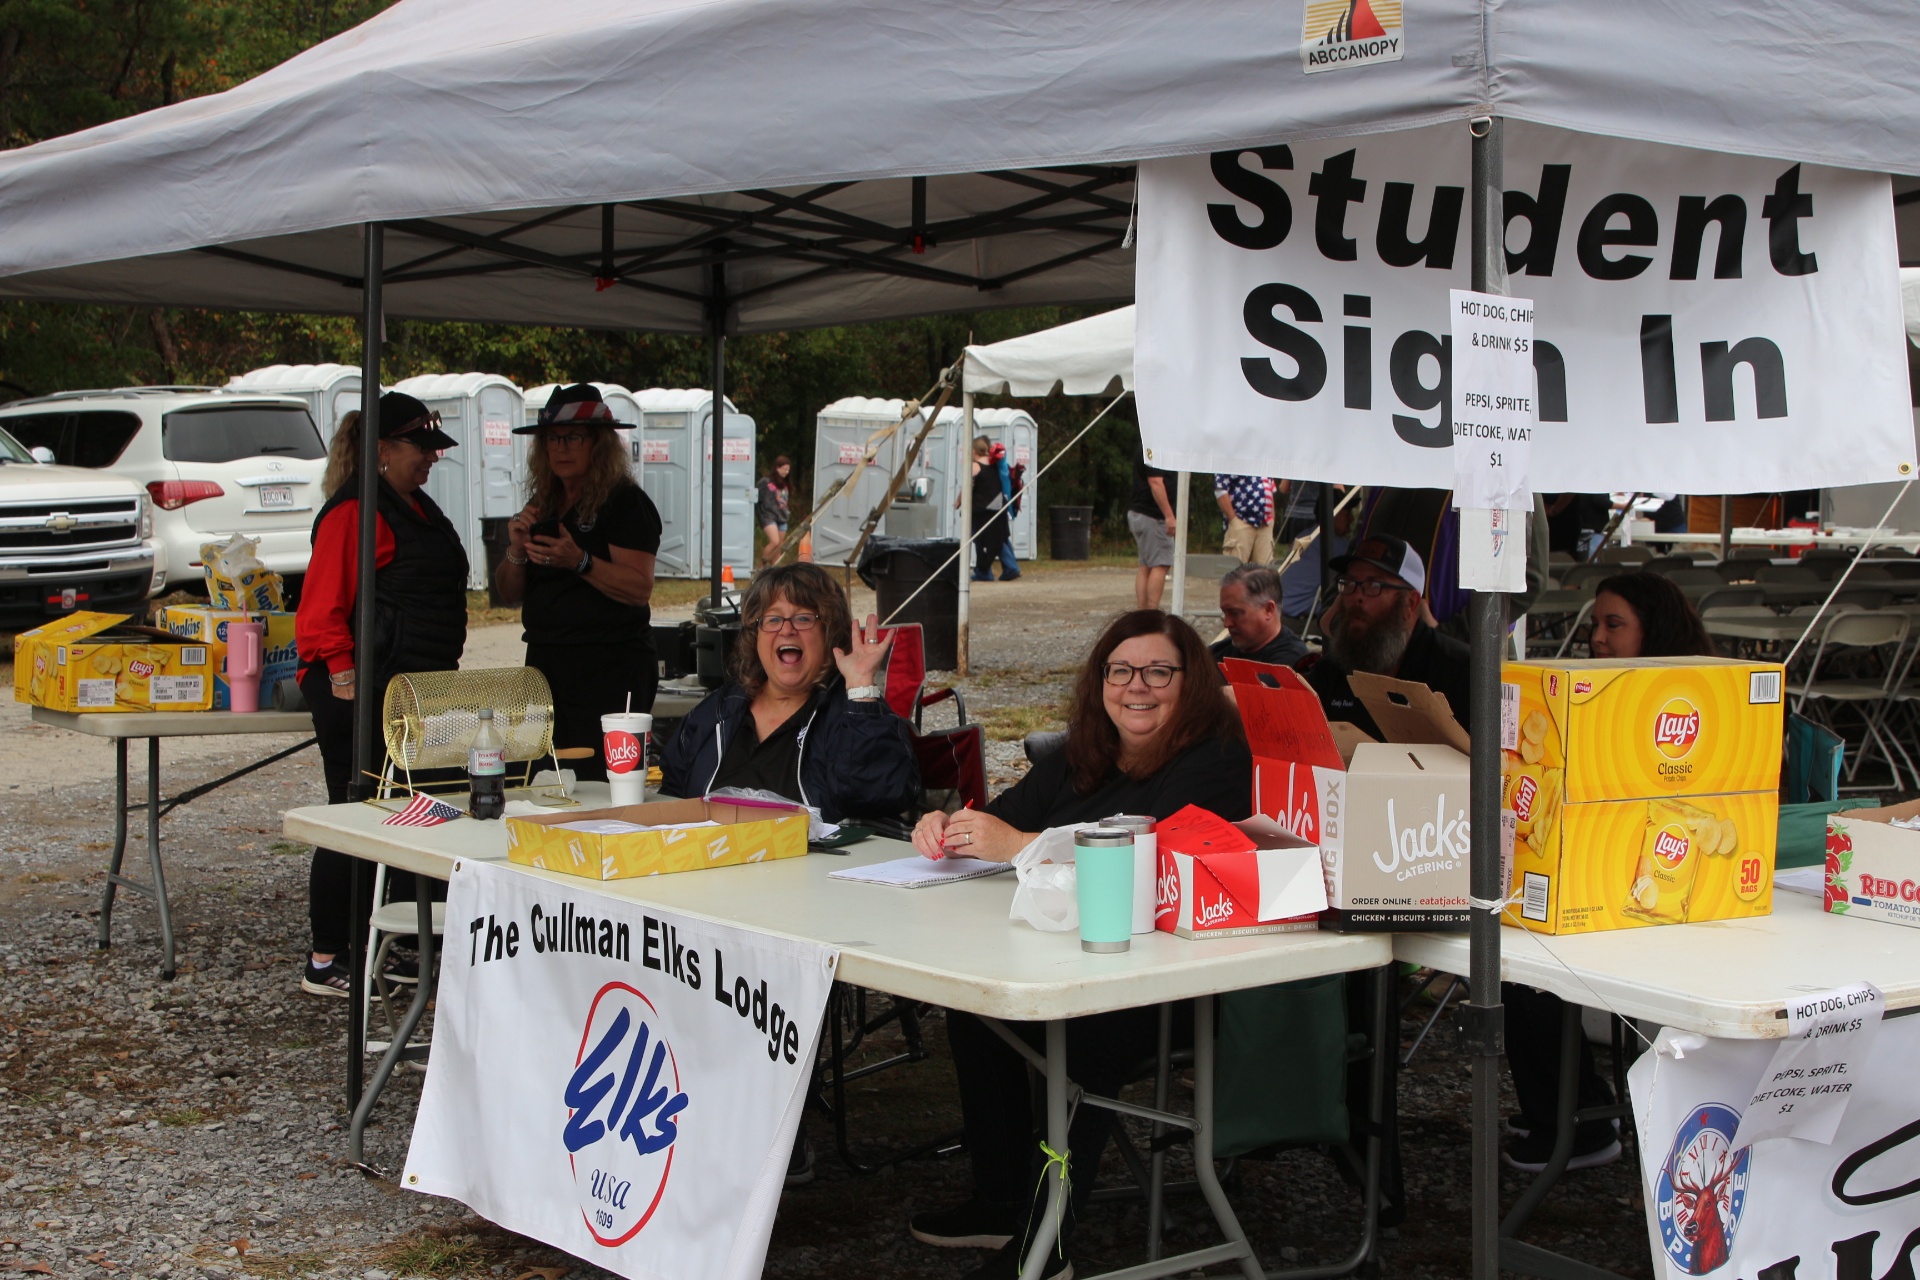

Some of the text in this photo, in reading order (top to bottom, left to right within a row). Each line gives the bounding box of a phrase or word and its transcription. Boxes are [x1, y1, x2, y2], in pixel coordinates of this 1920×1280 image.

[1309, 38, 1399, 66] ABCCANOPY
[1207, 144, 1818, 281] Student
[1461, 300, 1481, 316] HOT
[1483, 304, 1508, 323] DOG,
[1471, 332, 1529, 353] & DRINK $5
[1640, 314, 1788, 424] In
[1465, 392, 1532, 414] PEPSI, SPRITE,
[1454, 422, 1474, 437] DIET
[1476, 424, 1504, 442] COKE,
[1489, 451, 1503, 468] $1
[169, 617, 201, 636] Napkins
[1657, 713, 1697, 746] Lay's
[606, 737, 638, 764] Jack's
[1657, 762, 1693, 775] Classic
[1516, 777, 1537, 820] Lay's
[1325, 780, 1340, 898] BIG BOX
[1372, 793, 1470, 873] Jack's
[1656, 832, 1688, 861] Lay's
[1396, 860, 1453, 882] CATERING
[1653, 869, 1676, 883] Classic
[1740, 858, 1761, 885] 50
[1740, 884, 1758, 894] BAGS
[1859, 873, 1898, 899] RED
[1195, 892, 1234, 925] Jack's
[1351, 897, 1380, 906] ORDER
[1382, 897, 1412, 906] ONLINE
[1873, 900, 1910, 914] TOMATO
[1351, 914, 1386, 922] CHICKEN
[1392, 914, 1425, 922] BISCUITS
[1432, 914, 1453, 922] SIDES
[1887, 911, 1909, 920] KETCHUP
[1195, 930, 1223, 938] CHICKEN
[469, 902, 799, 1065] The Cullman Elks Lodge
[1796, 989, 1875, 1020] HOT DOG, CHIPS
[1803, 1018, 1863, 1039] & DRINK $5
[563, 1006, 689, 1156] Elks
[1772, 1063, 1848, 1082] PEPSI, SPRITE,
[1750, 1083, 1853, 1106] DIET COKE, WATER
[1778, 1103, 1794, 1115] $1
[595, 1208, 613, 1229] 1609
